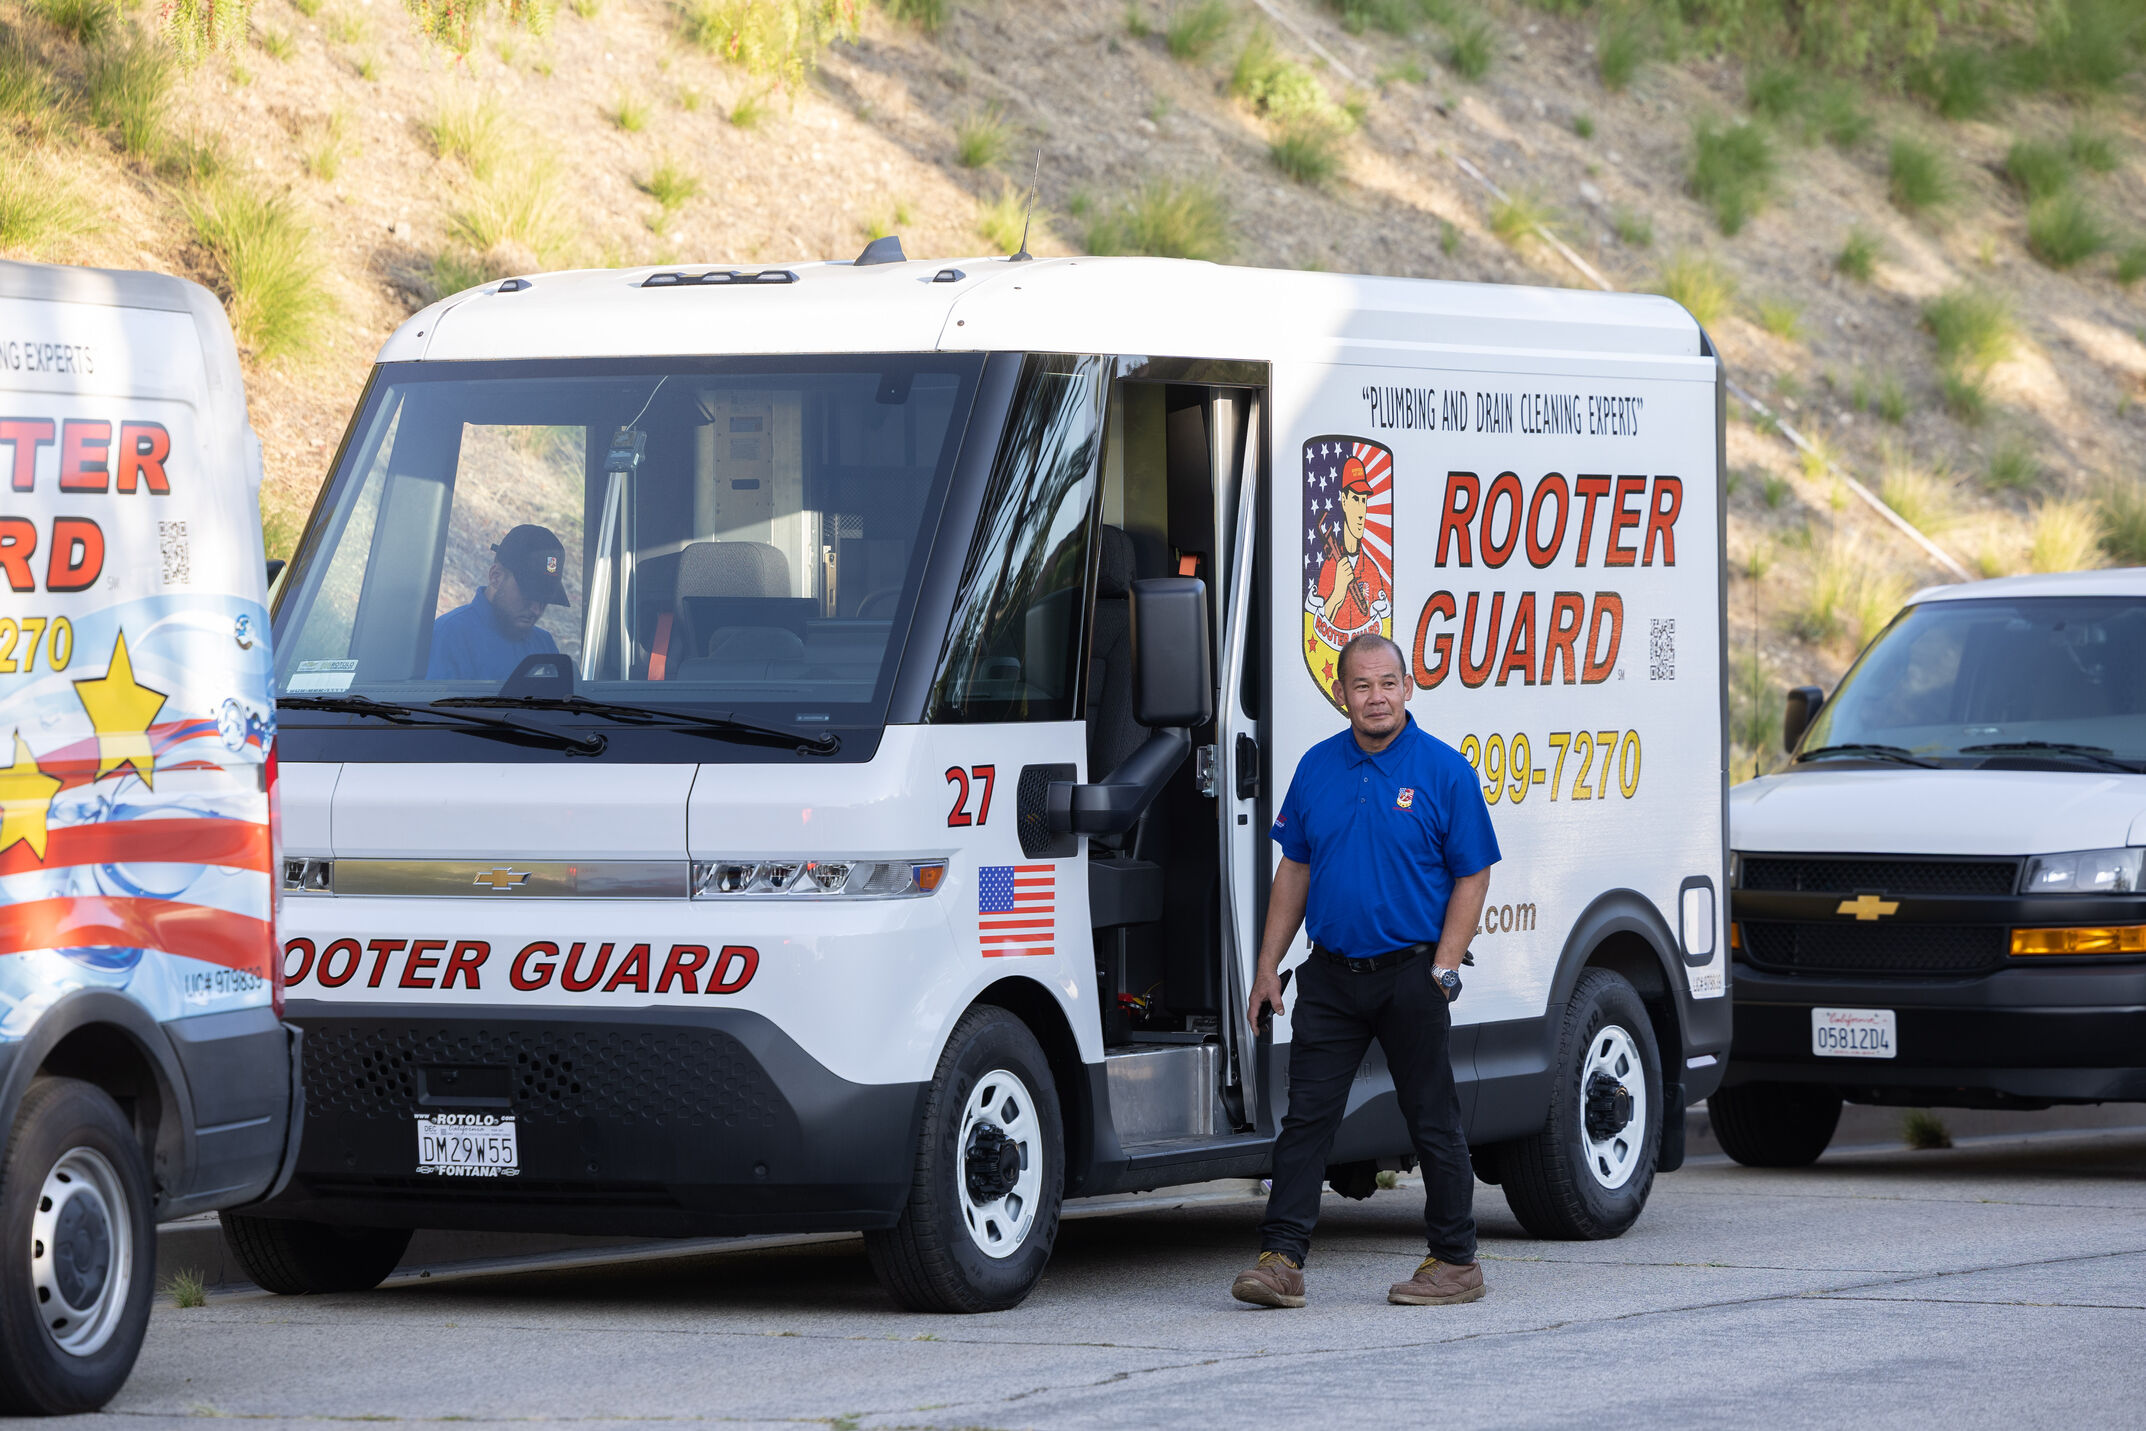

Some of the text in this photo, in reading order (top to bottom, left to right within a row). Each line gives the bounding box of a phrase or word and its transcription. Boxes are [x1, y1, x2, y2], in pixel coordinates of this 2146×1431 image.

[1442, 389, 1468, 432] AND
[1477, 391, 1513, 434] DRAIN
[1520, 393, 1582, 435] CLEANING
[1434, 470, 1683, 570] ROOTER
[1315, 615, 1349, 647] ROOTER
[1411, 589, 1624, 691] GUARD
[945, 764, 996, 828] 27
[283, 937, 760, 994] OOTER GUARD
[1818, 1027, 1889, 1050] 05812D4
[437, 1113, 494, 1126] ROTOLO
[448, 1124, 485, 1135] California
[423, 1136, 513, 1164] DM29W55
[438, 1165, 498, 1177] FONTANA
